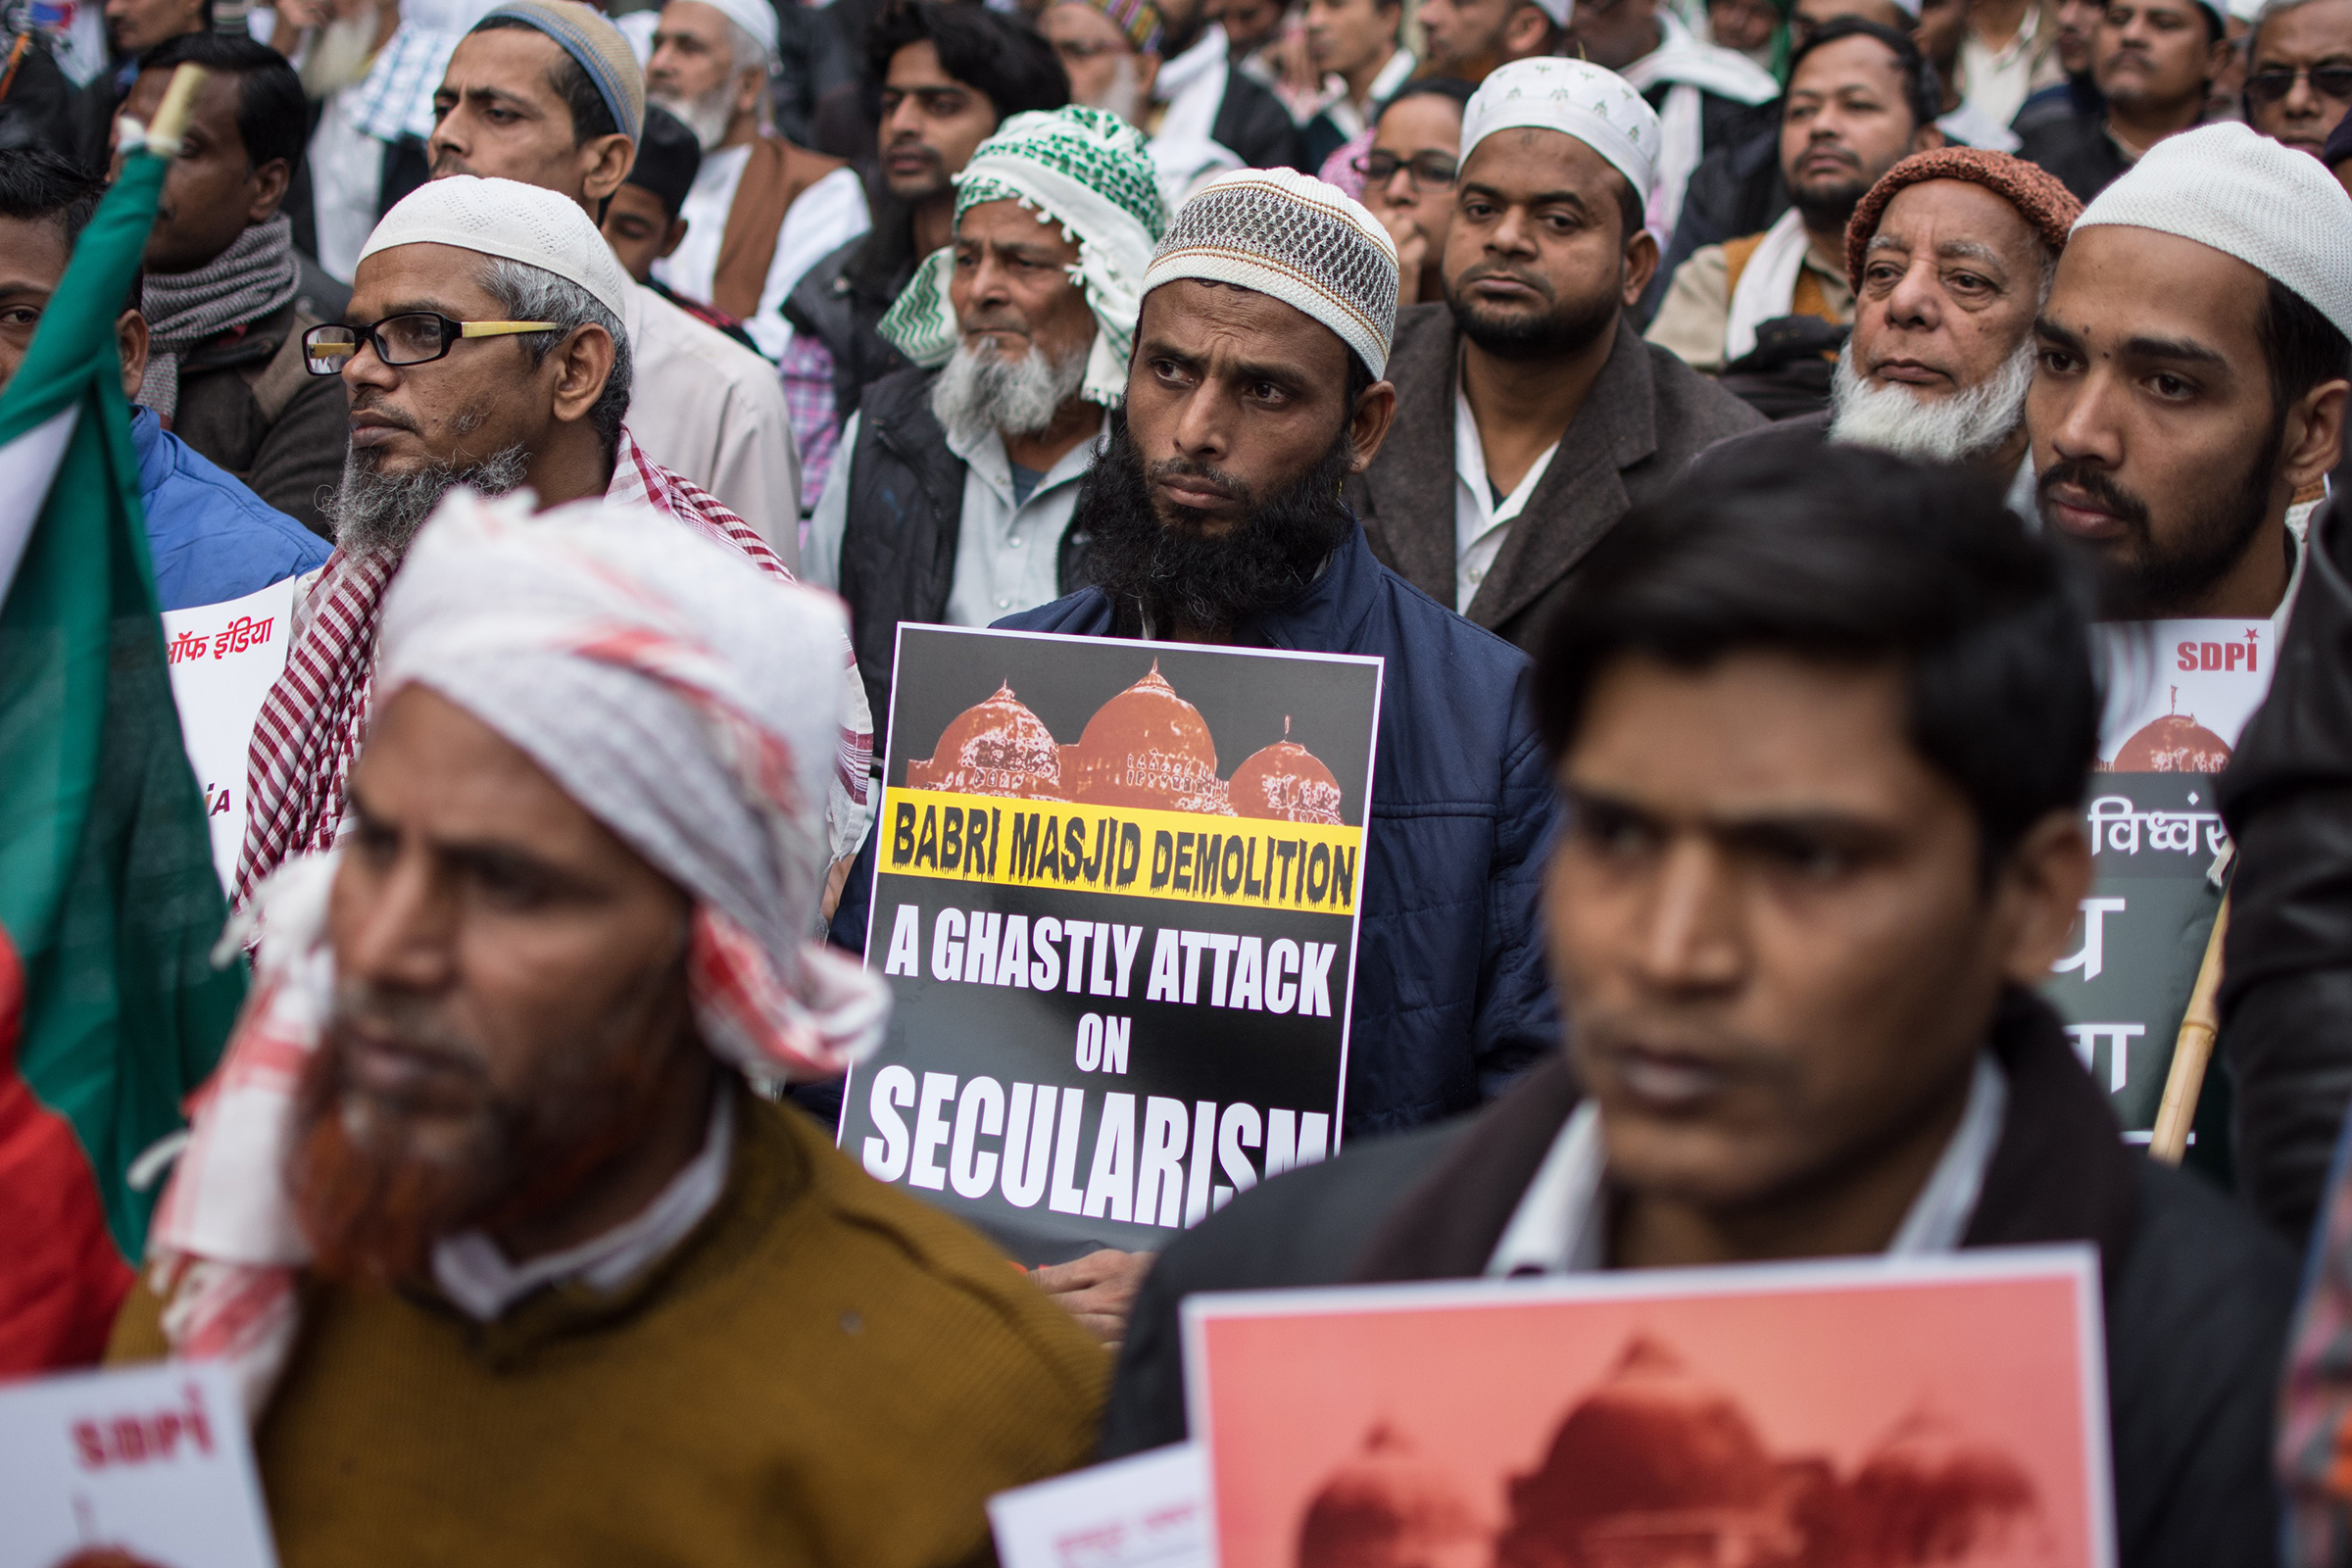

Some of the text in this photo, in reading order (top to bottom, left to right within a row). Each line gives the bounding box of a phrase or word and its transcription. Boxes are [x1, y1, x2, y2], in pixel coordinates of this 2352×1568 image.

[213, 615, 274, 660] इंडिया
[2177, 639, 2258, 672] SDPI
[891, 802, 1356, 908] BABRI MASJID DEMOLITION
[885, 905, 1337, 1017] A GHASTLY ATTACK
[1075, 1012, 1131, 1074] ON
